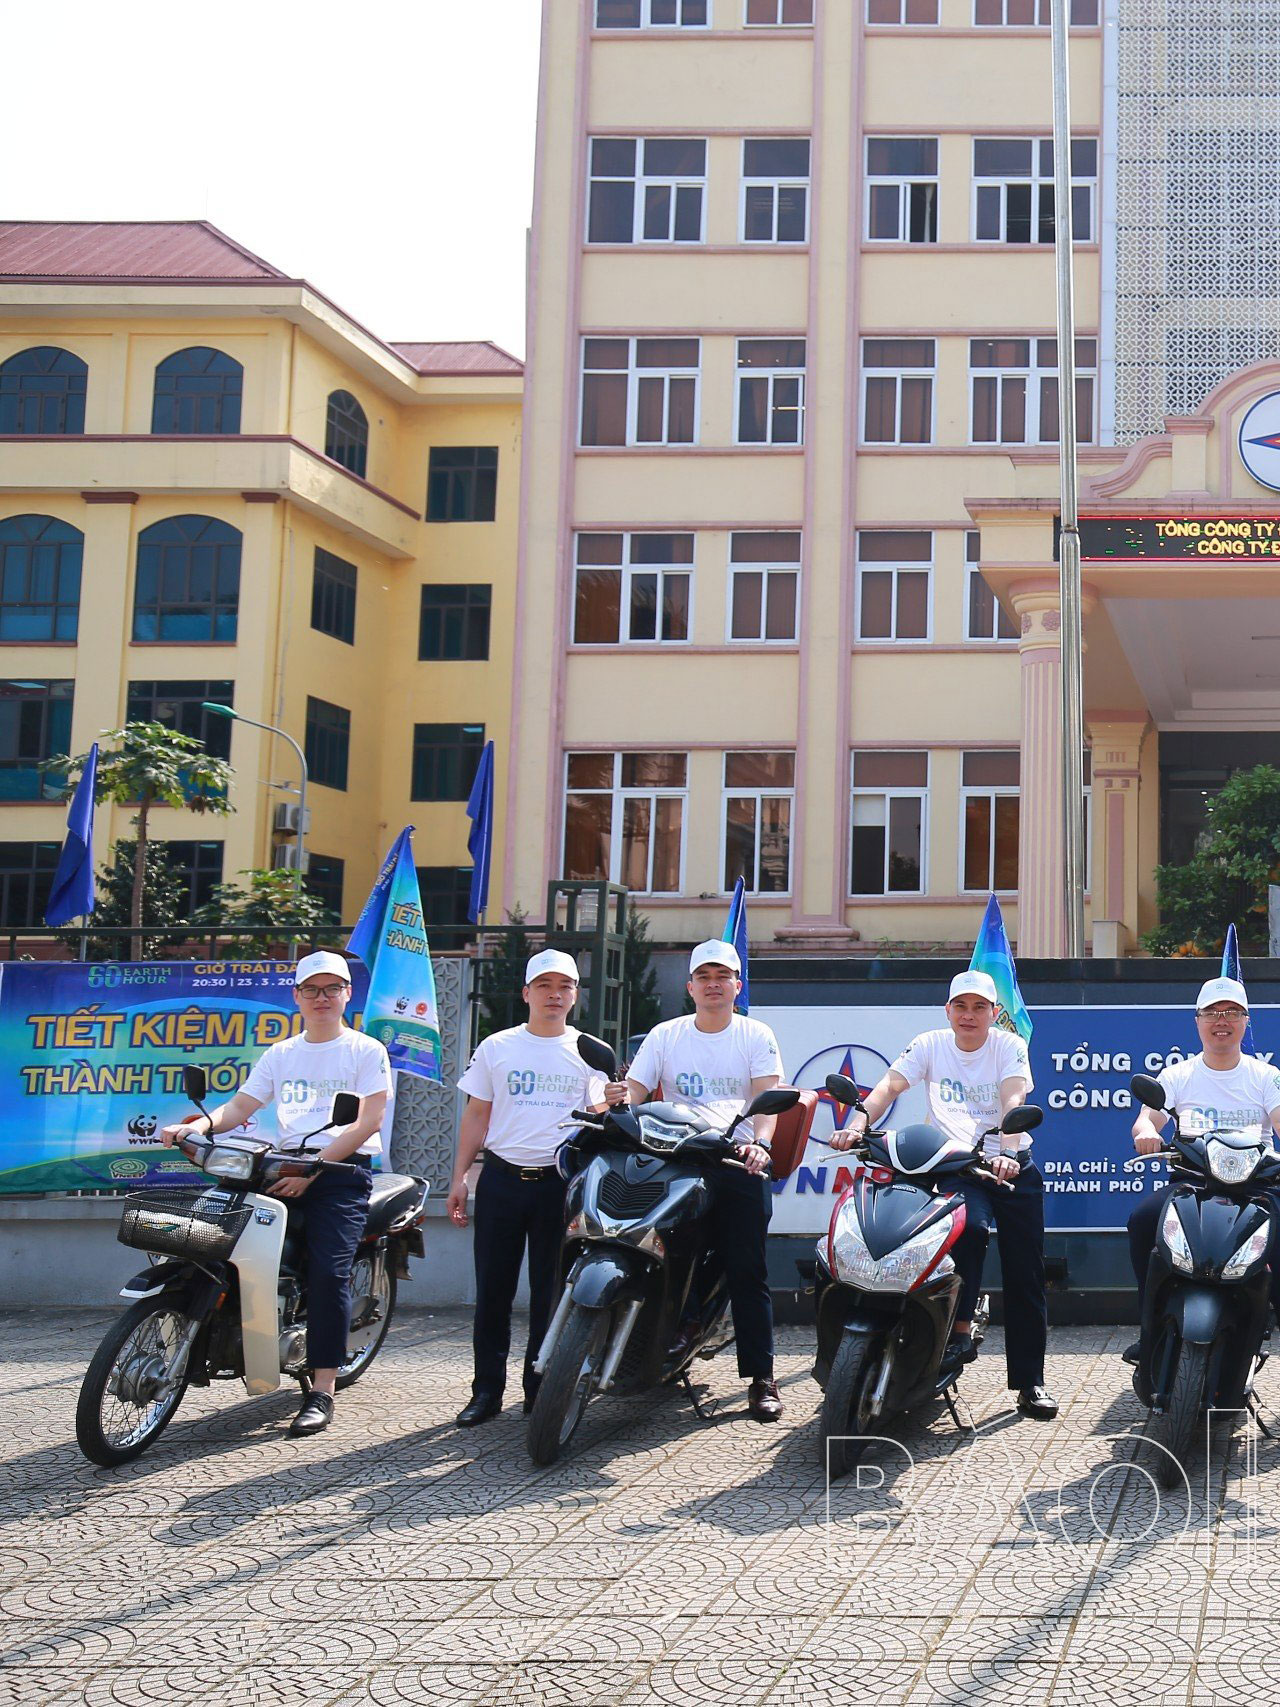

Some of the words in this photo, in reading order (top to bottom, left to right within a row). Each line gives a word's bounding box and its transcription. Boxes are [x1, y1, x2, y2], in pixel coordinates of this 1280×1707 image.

[1204, 519, 1252, 537] CÔNG
[1197, 537, 1245, 555] CÔNG
[87, 965, 123, 988] 60
[123, 967, 172, 976] EARTH
[194, 962, 226, 975] GIỜ
[231, 962, 271, 974] TRÁI
[123, 976, 168, 985] HOUR
[192, 978, 227, 987] 20:30
[27, 1003, 125, 1048] TIẾT
[130, 1005, 251, 1053] KIỆM
[1051, 1041, 1131, 1073] TỔNG
[22, 1059, 151, 1094] THÀNH
[507, 1070, 535, 1096] 60
[537, 1073, 579, 1084] EARTH
[676, 1072, 703, 1097] 60
[280, 1078, 309, 1104] 60
[309, 1080, 348, 1089] EARTH
[939, 1078, 965, 1103] 60
[963, 1081, 999, 1094] EARTH
[1048, 1083, 1132, 1109] CÔNG
[1220, 1109, 1262, 1119] EARTH
[1044, 1161, 1073, 1178] ĐỊA
[1151, 1161, 1162, 1173] 9
[1043, 1178, 1101, 1193] THÀNH
[1109, 1176, 1145, 1193] PHỐ
